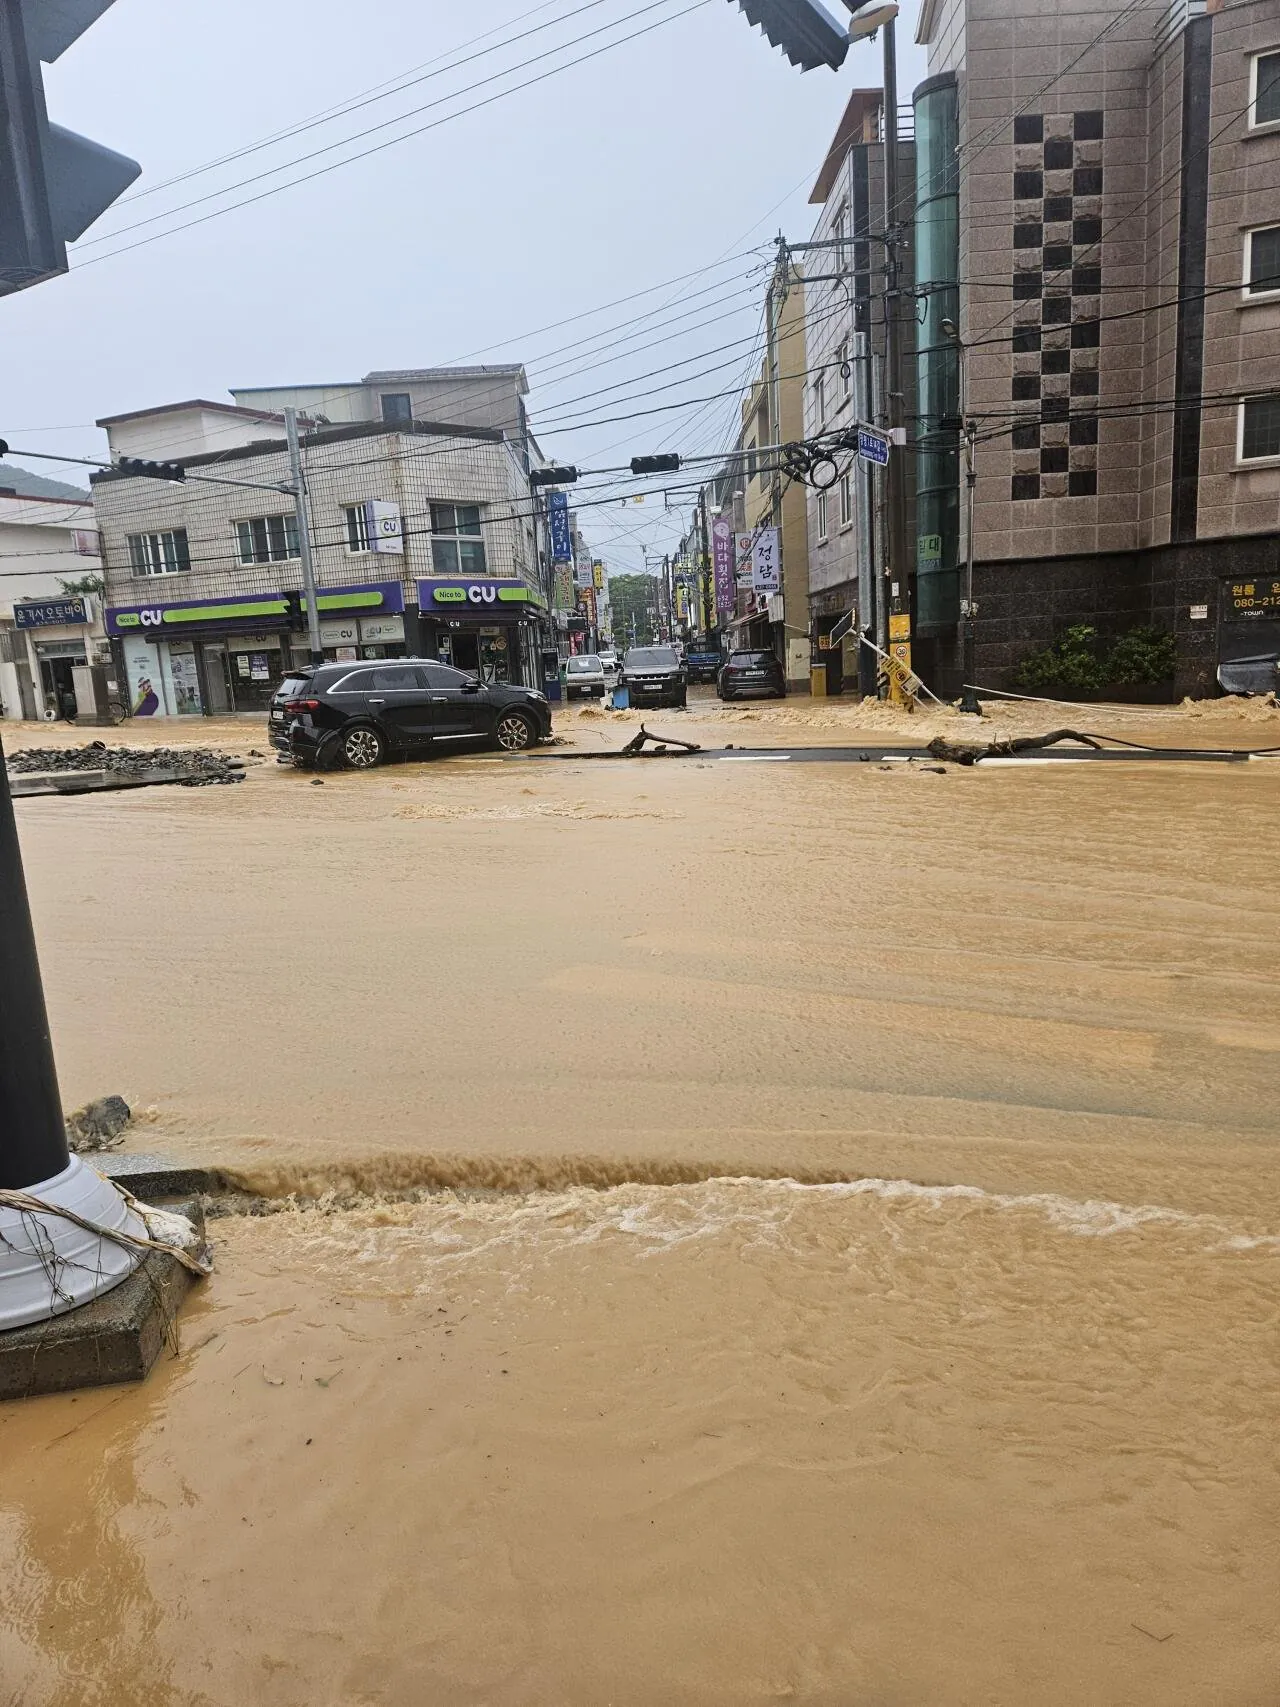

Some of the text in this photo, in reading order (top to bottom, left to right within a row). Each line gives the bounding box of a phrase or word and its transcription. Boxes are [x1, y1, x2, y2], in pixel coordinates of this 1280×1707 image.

[383, 521, 396, 531] CU
[717, 541, 729, 589] 바다횟집
[758, 545, 773, 579] 정담
[469, 586, 496, 602] CU
[140, 610, 161, 626] CU
[341, 629, 353, 638] CU
